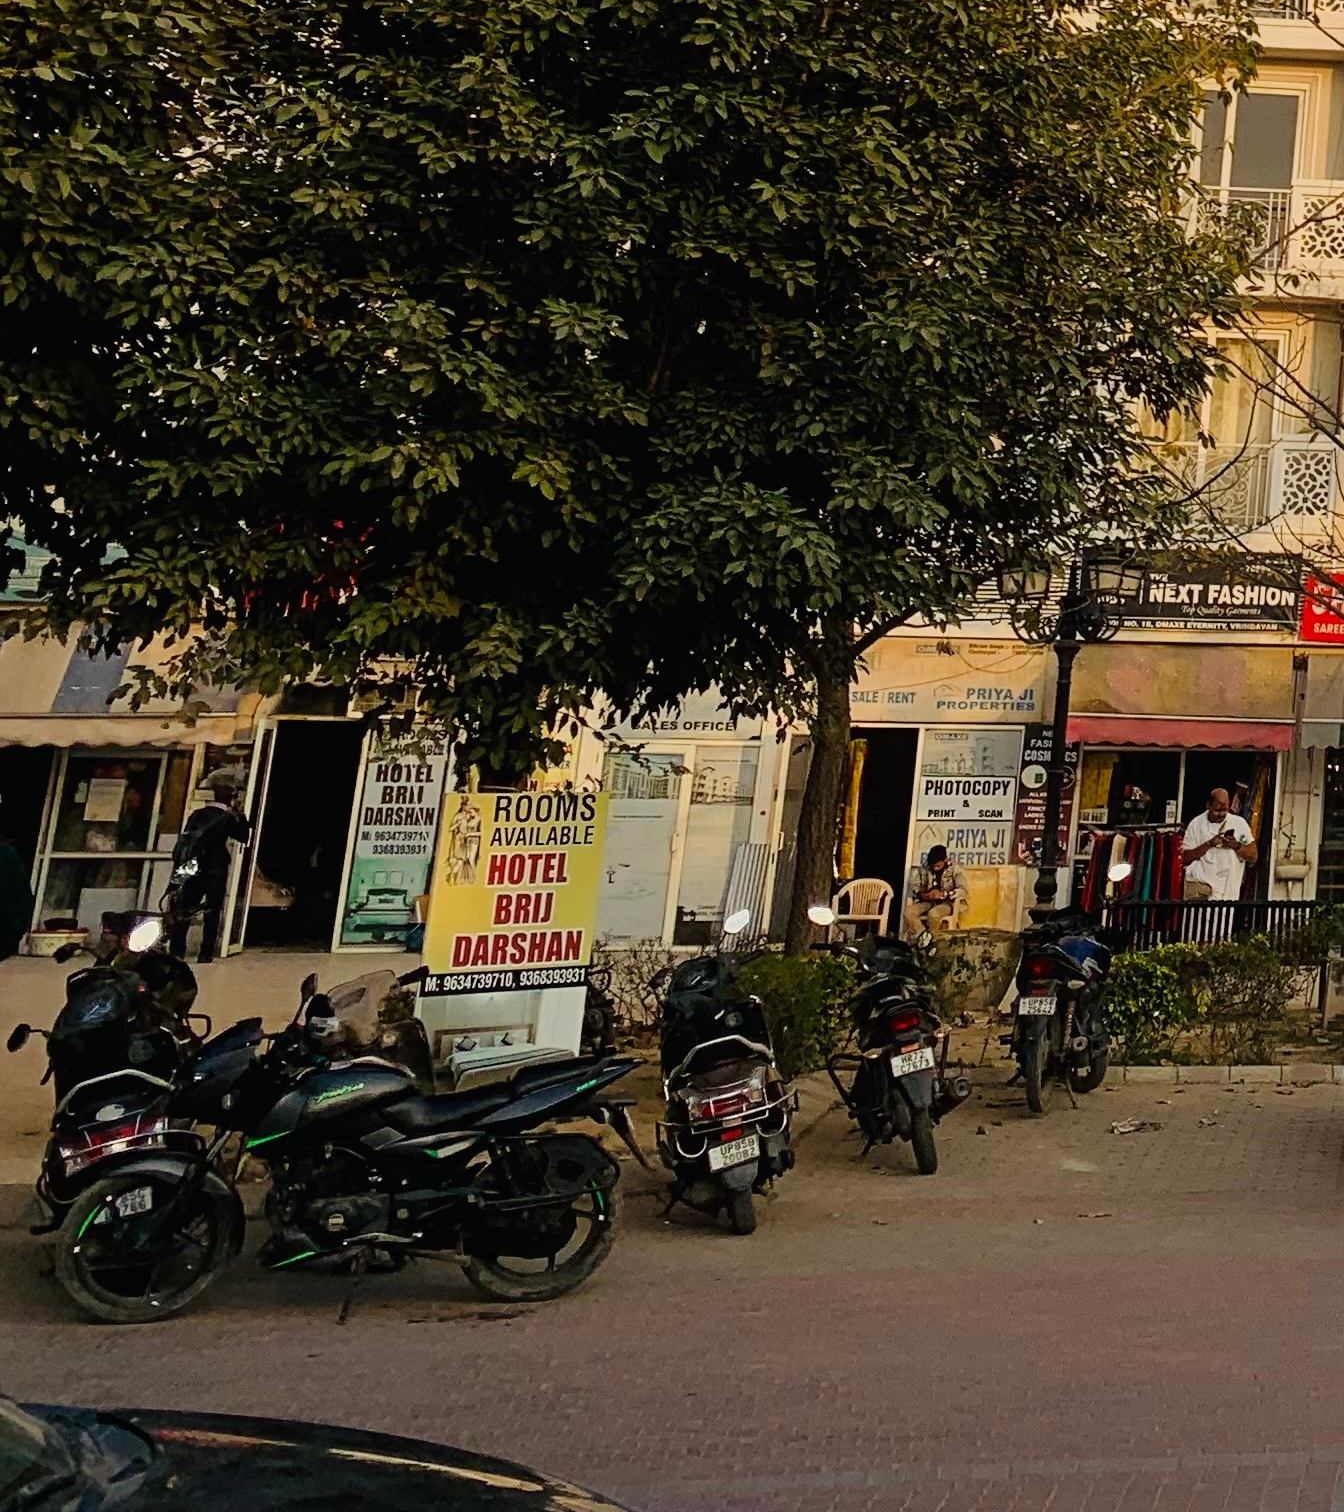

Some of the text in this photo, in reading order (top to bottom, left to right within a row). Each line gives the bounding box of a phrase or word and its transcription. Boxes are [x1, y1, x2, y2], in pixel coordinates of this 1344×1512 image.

[1149, 583, 1296, 606] NEXT FASHION
[1196, 606, 1225, 616] Quality
[850, 691, 878, 704] SALE
[887, 692, 916, 704] RENT
[966, 688, 1034, 701] PRIYA JI
[936, 700, 1036, 711] PROPERTIES
[682, 720, 735, 732] OFFICE
[375, 763, 434, 783] HOTEL
[924, 780, 1011, 796] PHOTOCOPY
[494, 793, 597, 823] ROOMS
[962, 800, 970, 808] &
[363, 807, 435, 826] DARSHAN
[927, 810, 1003, 818] PRINT SCAN
[490, 825, 595, 847] AVAILABLE
[946, 829, 1006, 848] PRIYA JI
[921, 851, 1006, 866] PPERTIES
[487, 852, 568, 886] HOTEL
[493, 892, 554, 925] BRIJ
[451, 930, 583, 968] DARSHAN
[425, 967, 586, 992] M: 9634739710, 9368393931
